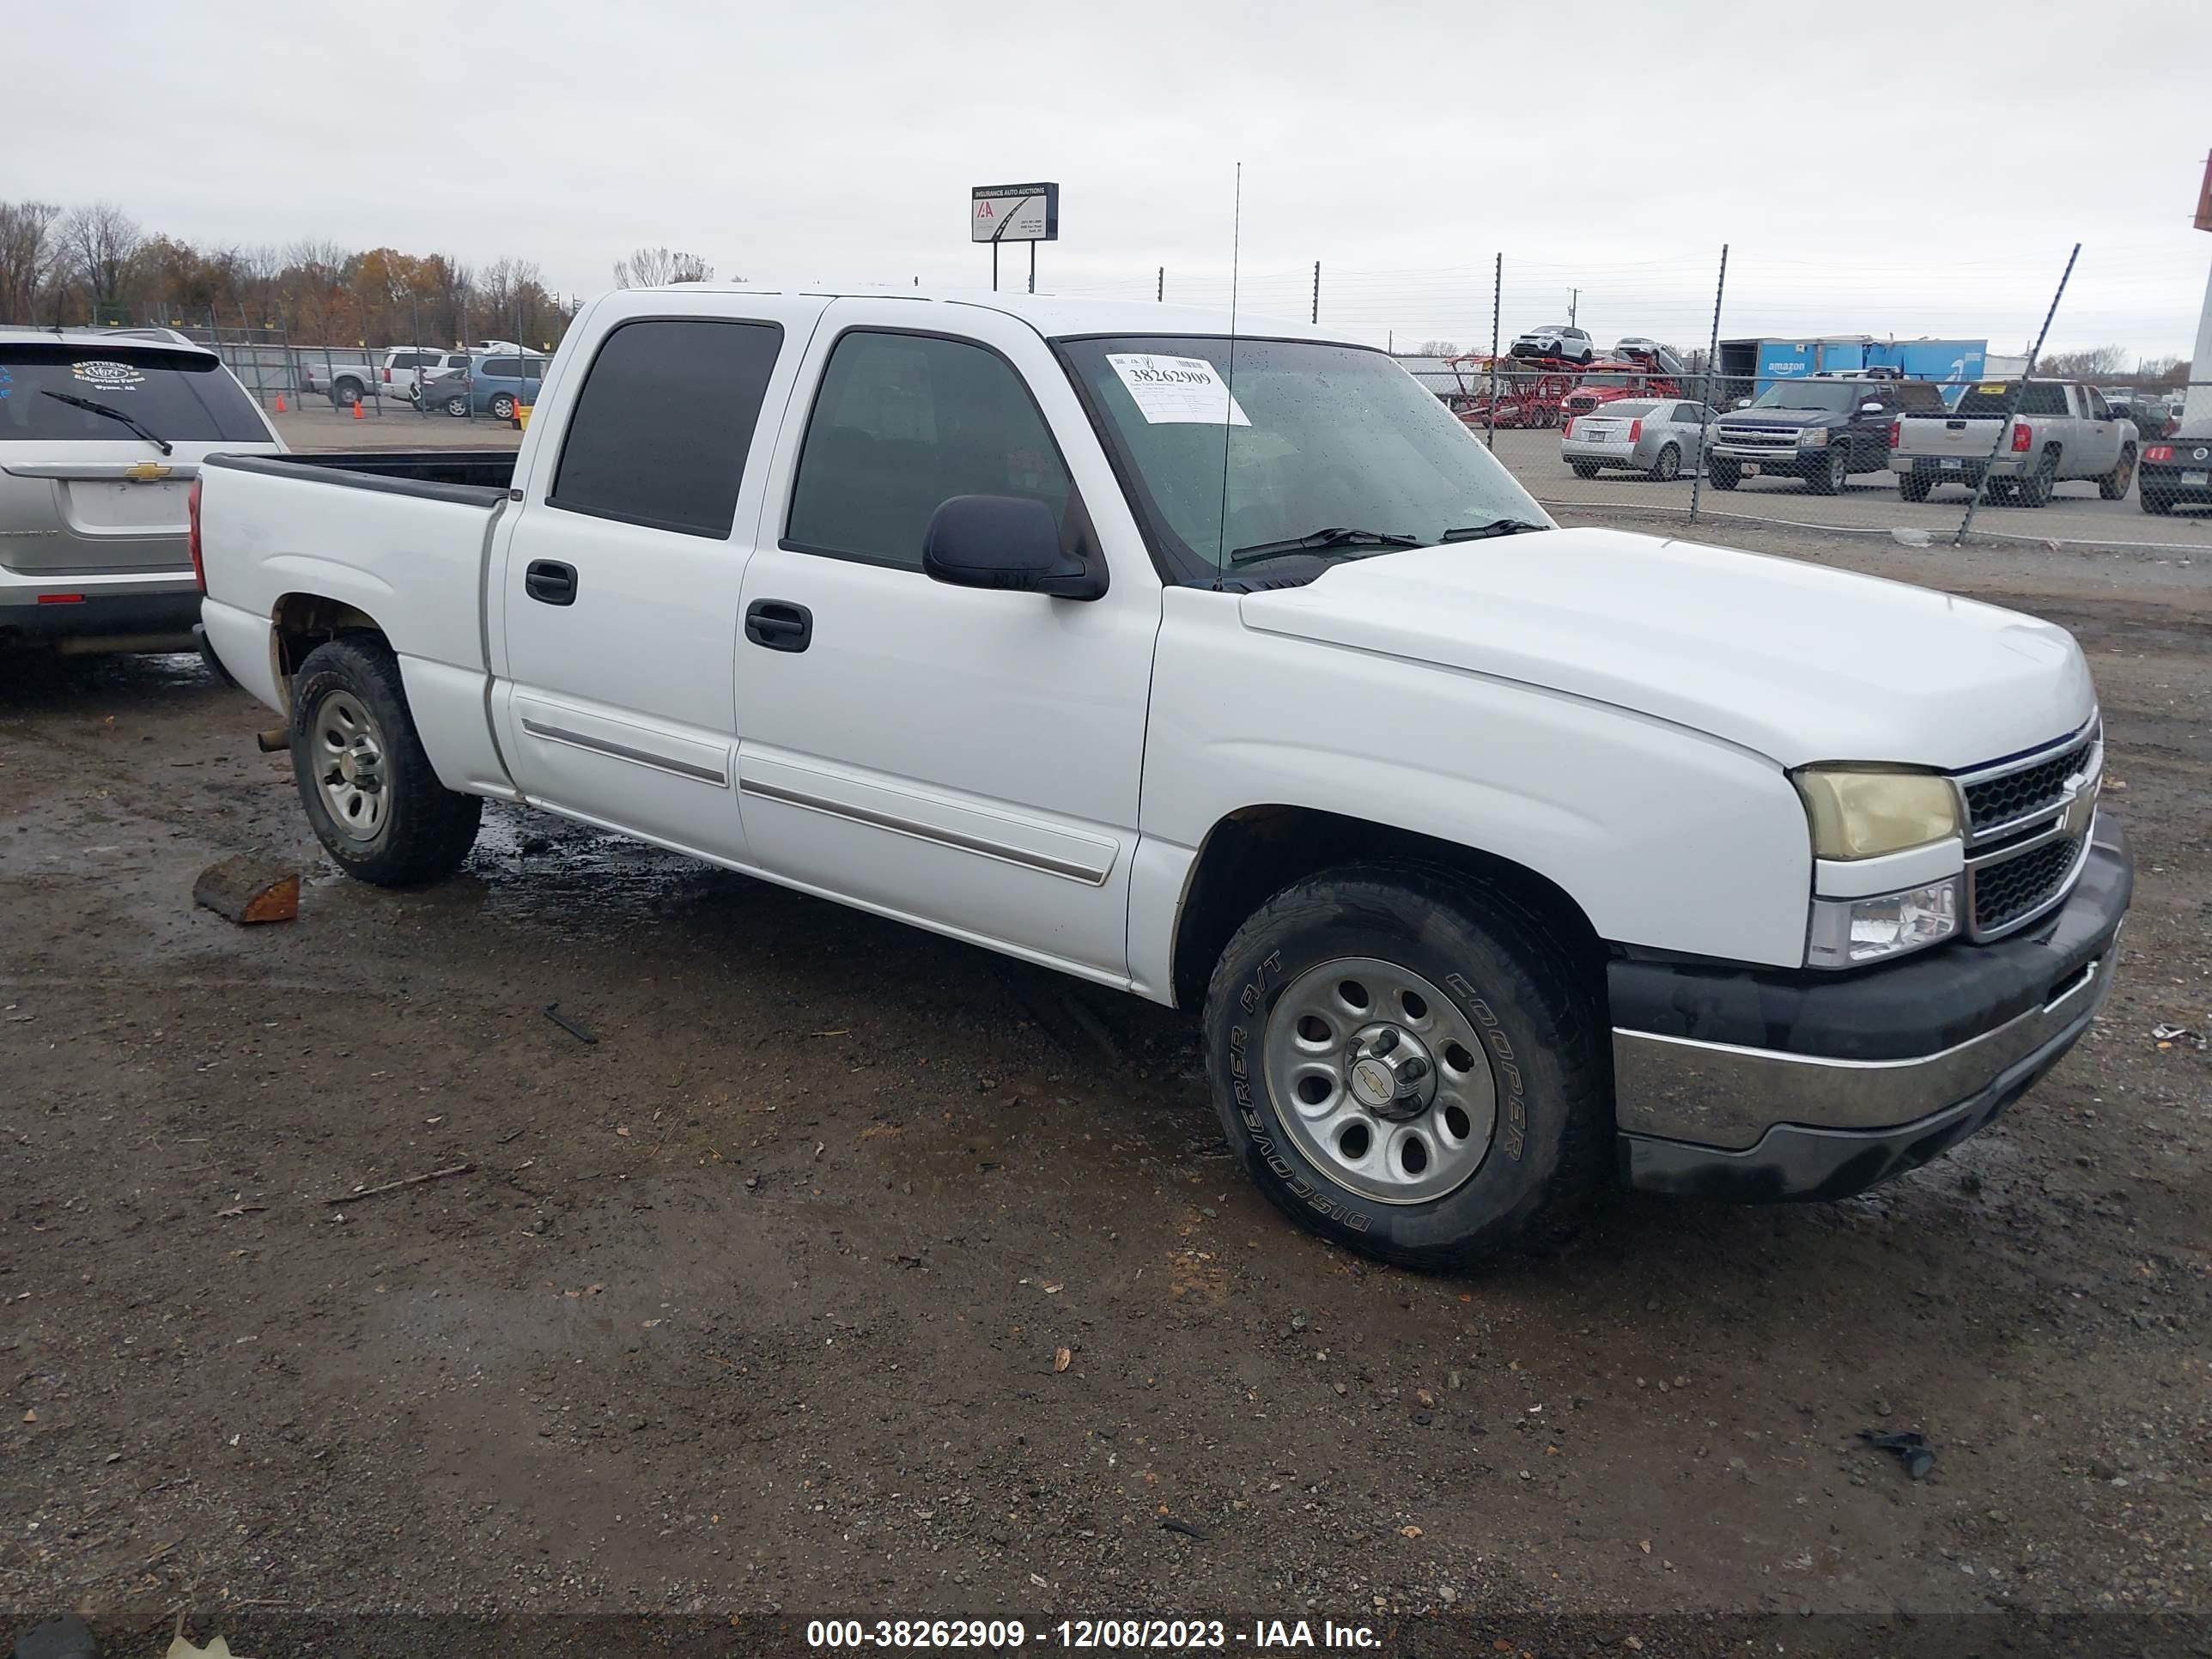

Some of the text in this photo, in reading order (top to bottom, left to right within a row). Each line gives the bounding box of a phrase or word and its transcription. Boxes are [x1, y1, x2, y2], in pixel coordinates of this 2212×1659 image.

[975, 186, 1045, 198] INSURANCE AUTO AUCTIONS
[71, 361, 134, 370] MATTHEWS
[1768, 362, 1806, 371] amazon
[1128, 369, 1211, 386] 38262909
[1445, 971, 1528, 1162] COOPER
[1230, 949, 1374, 1233] DISCOVERER A/T
